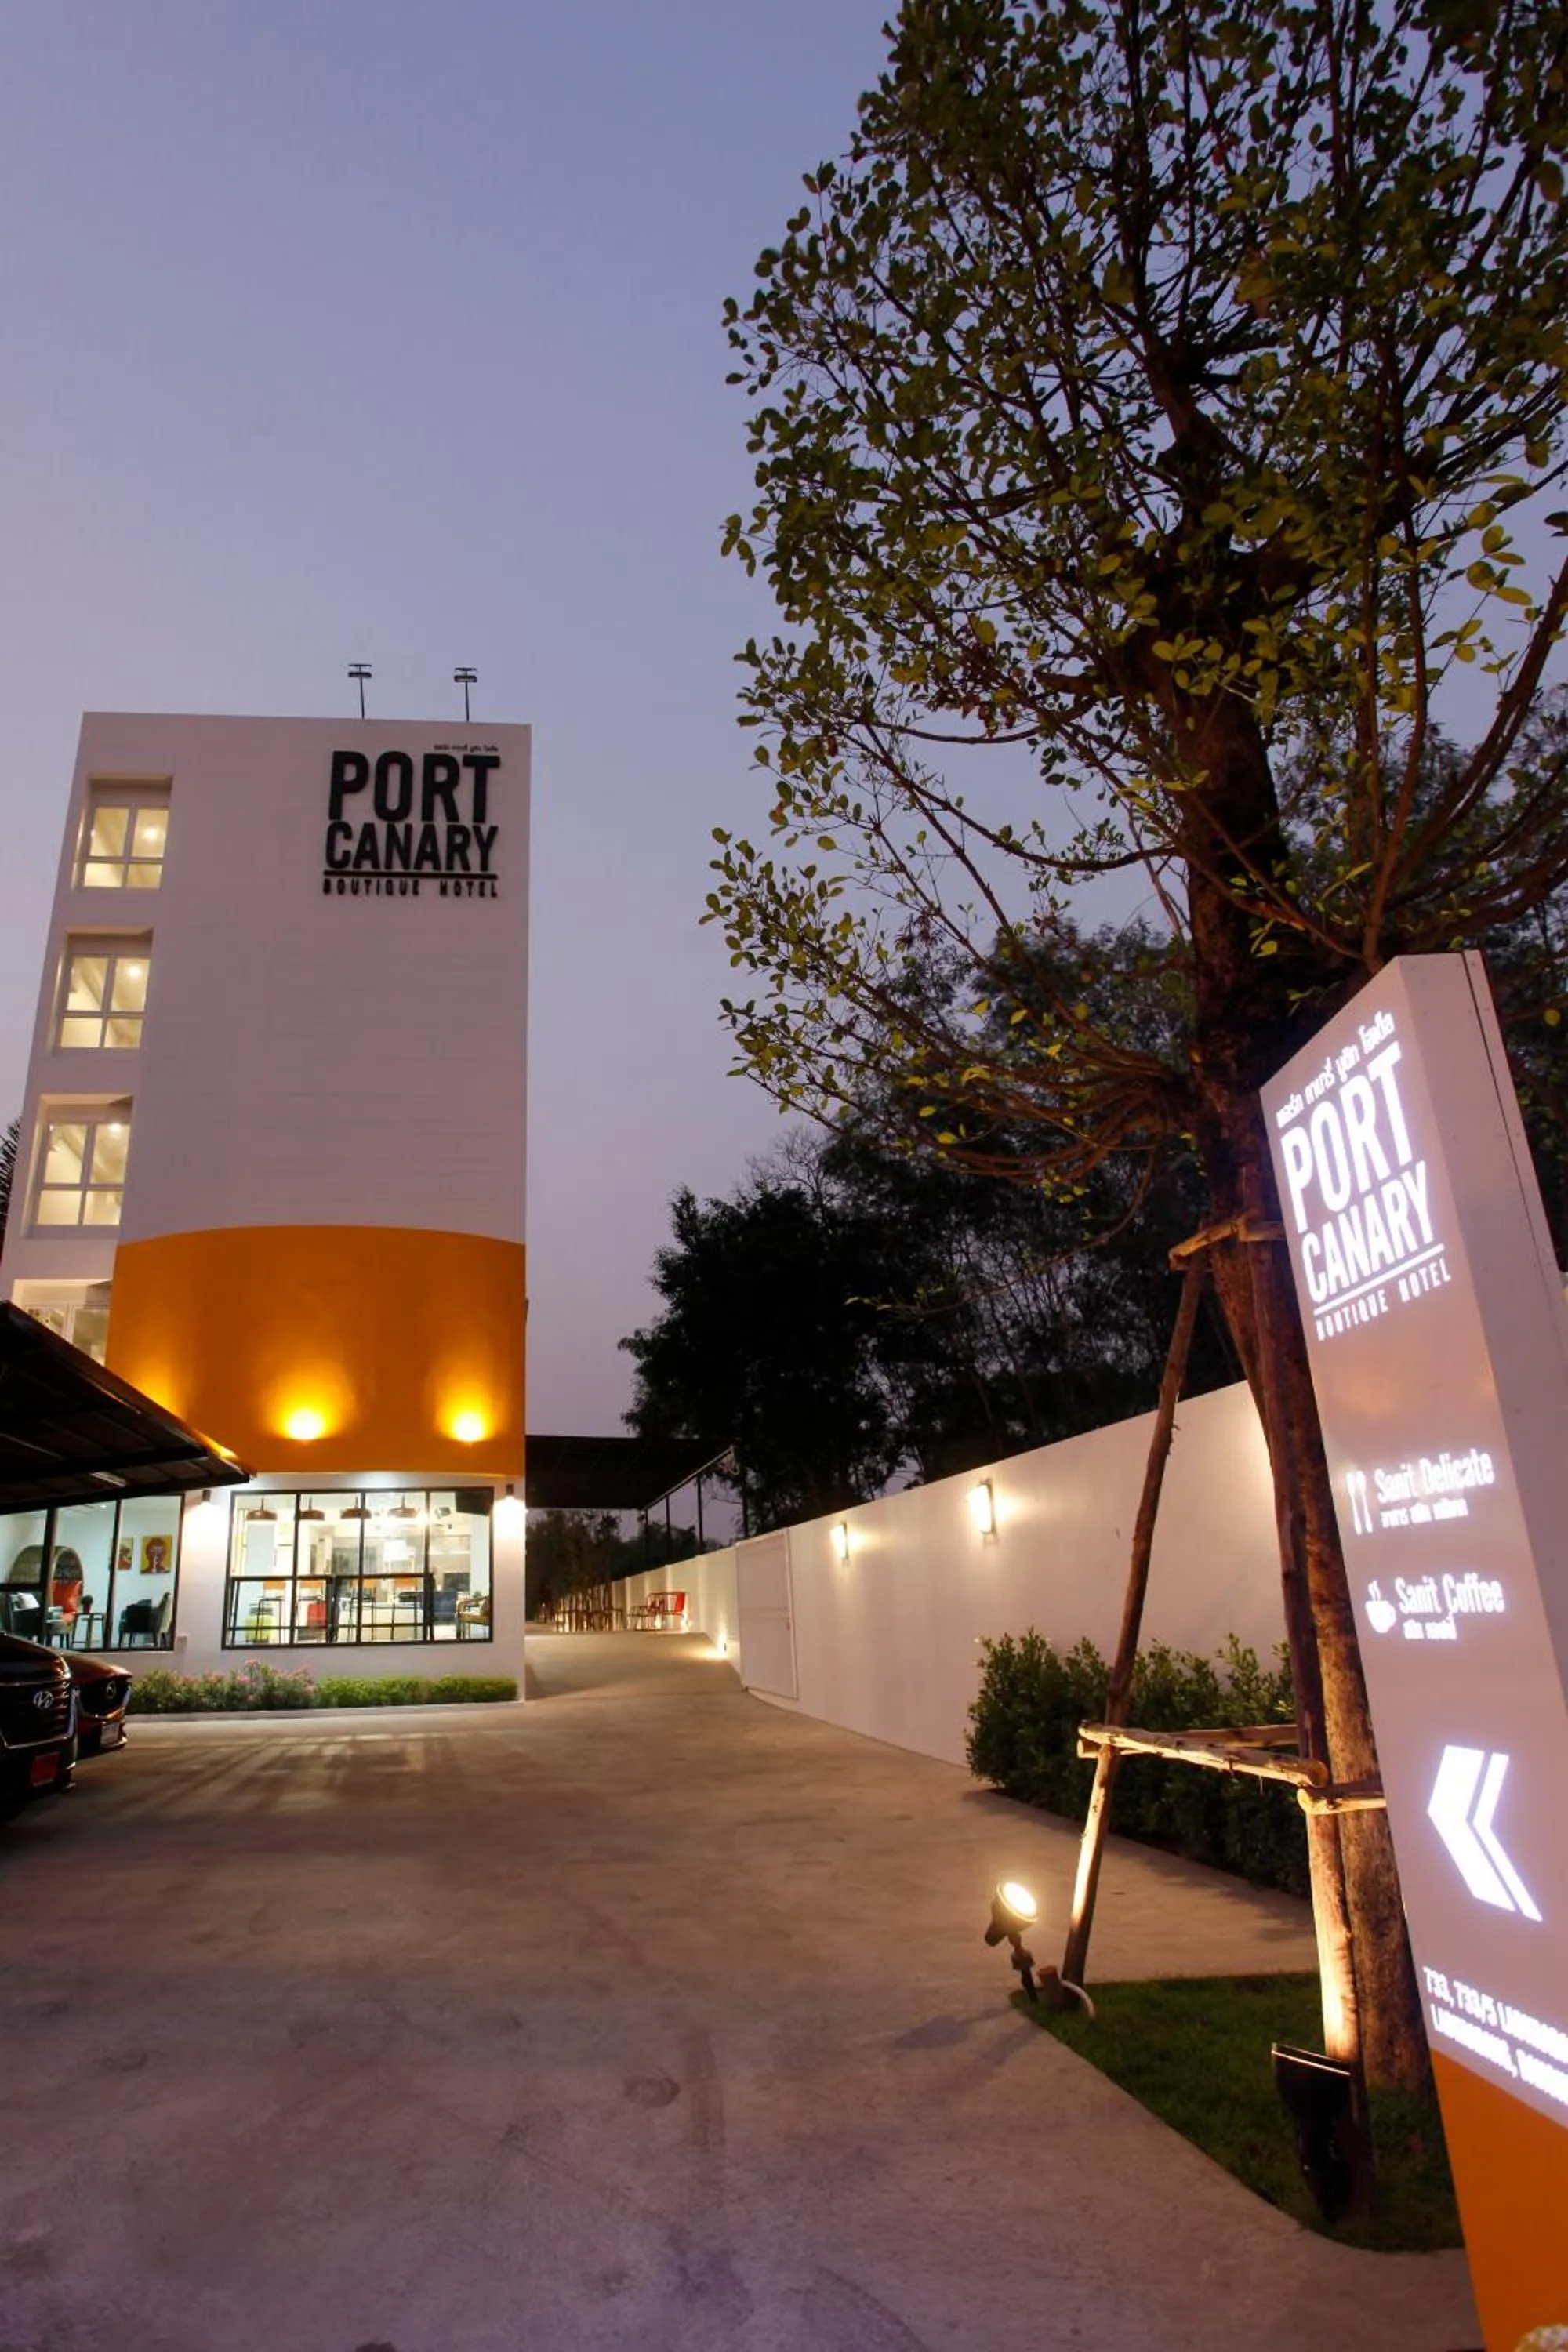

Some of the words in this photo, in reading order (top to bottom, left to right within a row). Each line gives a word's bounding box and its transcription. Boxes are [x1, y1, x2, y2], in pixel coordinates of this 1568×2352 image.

[328, 750, 500, 823] PORT
[325, 820, 499, 872] CANARY
[323, 879, 419, 896] BOUTIQUE
[439, 880, 498, 898] HOTEL
[1281, 1041, 1412, 1234] PORT
[1302, 1160, 1434, 1304] CANARY
[1316, 1290, 1389, 1341] BOUTIQUE
[1399, 1258, 1452, 1304] HOTEL
[1418, 1448, 1495, 1495] Delicate
[1442, 1572, 1504, 1613] Coffee
